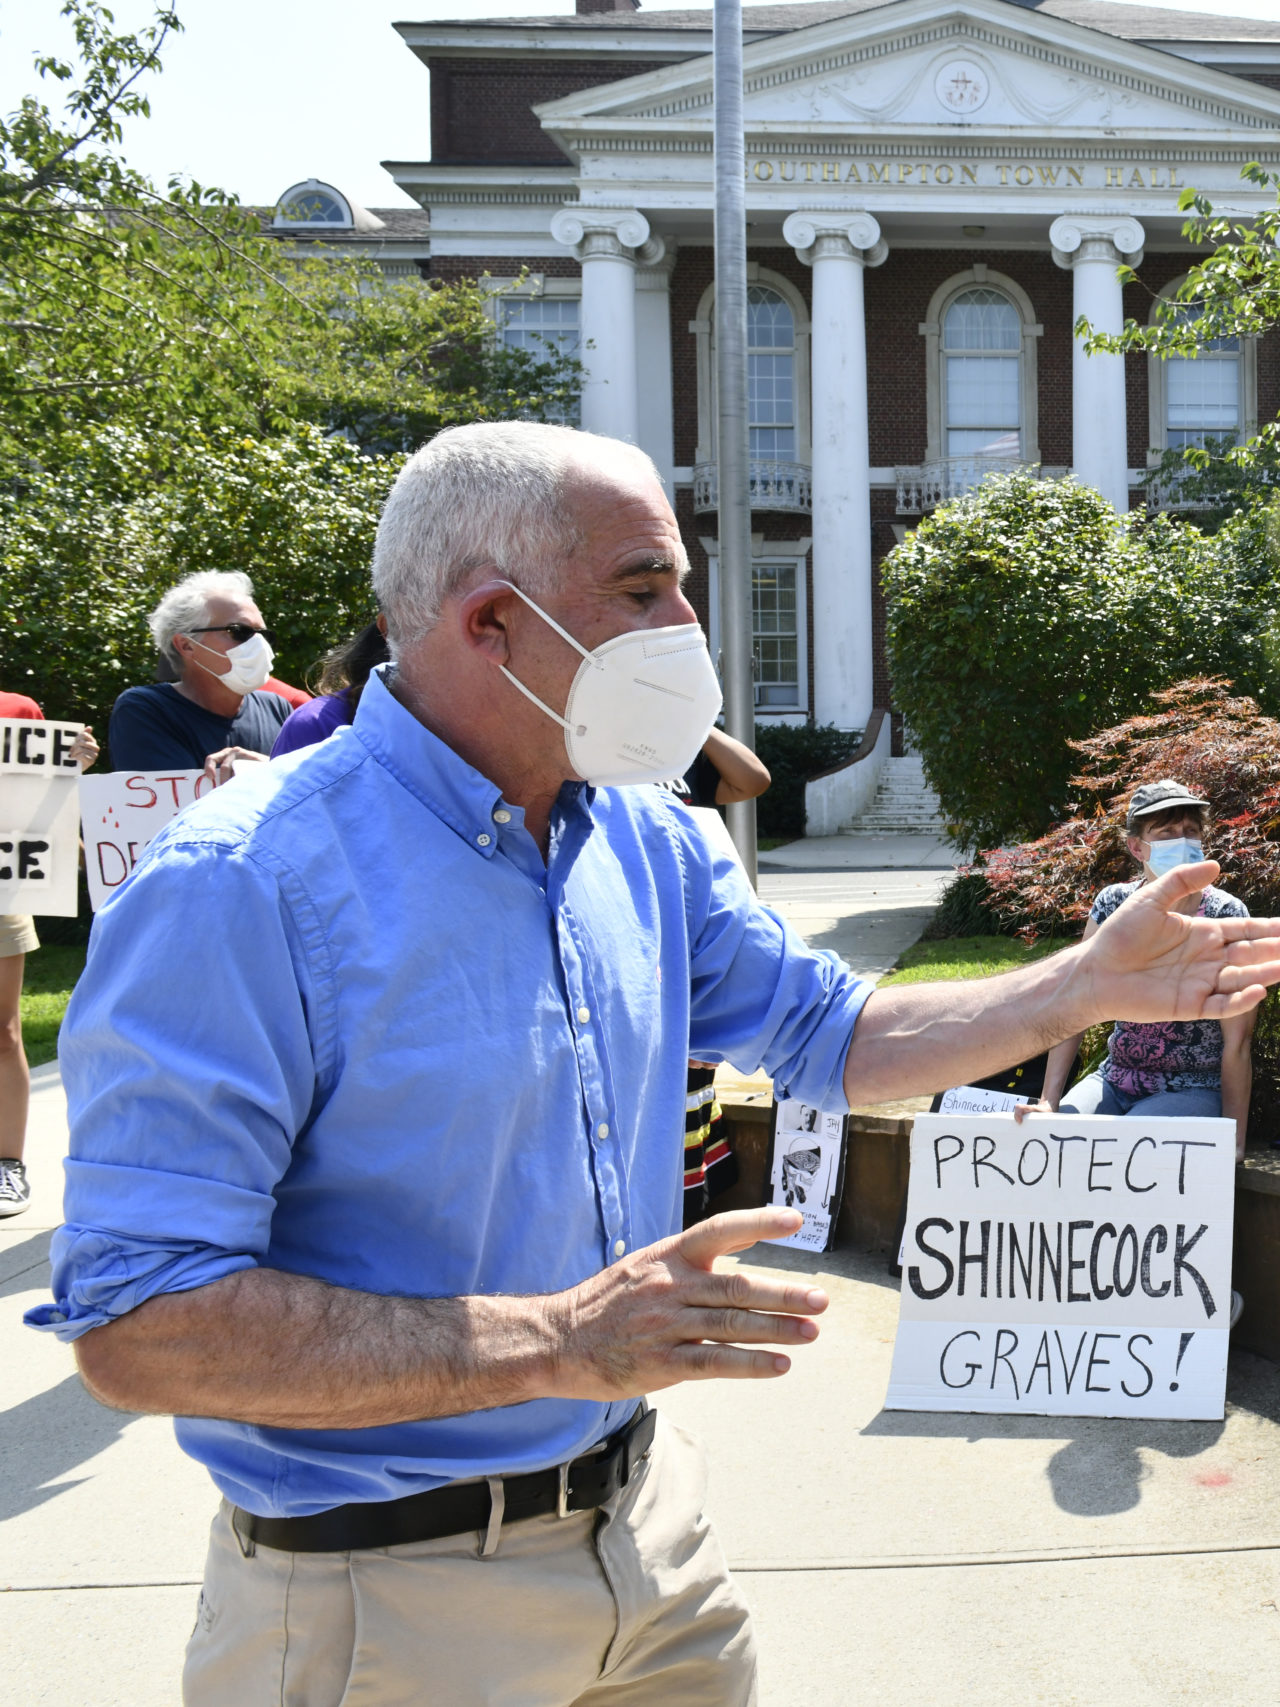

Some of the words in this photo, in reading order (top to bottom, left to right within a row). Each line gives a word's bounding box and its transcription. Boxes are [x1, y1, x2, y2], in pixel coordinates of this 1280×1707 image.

[995, 164, 1086, 186] TOWN
[1104, 166, 1186, 189] HALL
[932, 1133, 1217, 1195] PROTECT
[907, 1217, 1218, 1320] SHINNECOCK
[939, 1328, 1196, 1401] GRAVES!
